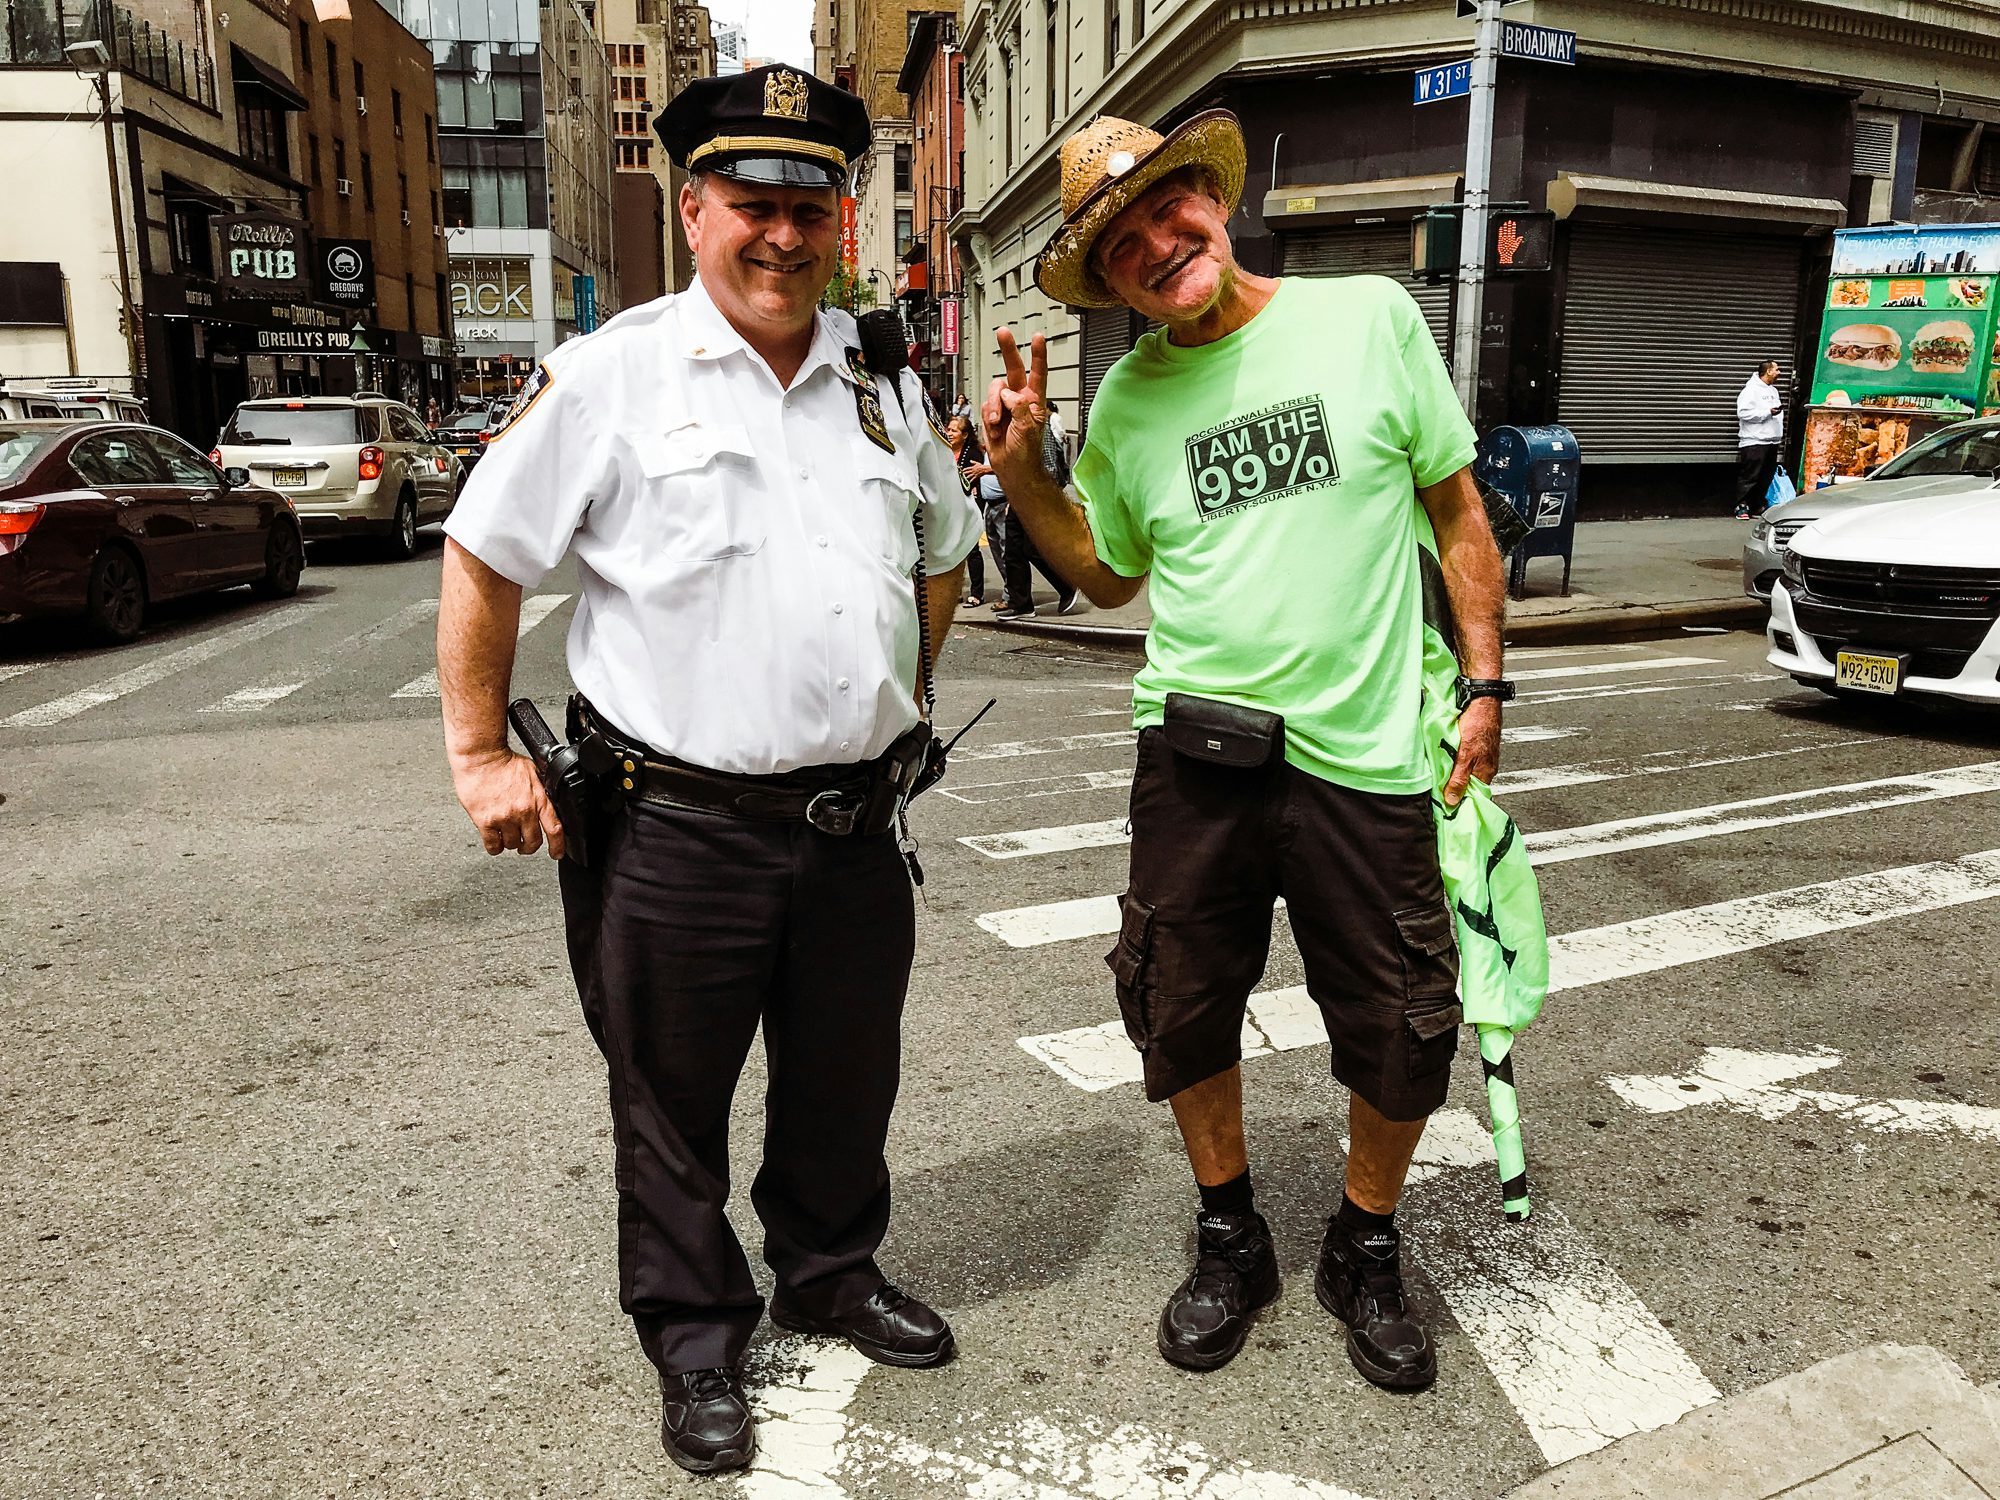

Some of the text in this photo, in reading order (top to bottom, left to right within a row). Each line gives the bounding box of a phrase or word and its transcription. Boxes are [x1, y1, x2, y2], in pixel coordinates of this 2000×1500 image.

[1506, 26, 1573, 60] BROADWAY
[1419, 65, 1467, 99] W 31 ST
[228, 224, 294, 247] O'Reilly's
[1869, 237, 1897, 250] YORK
[1897, 236, 1928, 250] BEST
[1928, 235, 1964, 249] HALAL
[229, 247, 297, 279] PUB
[330, 282, 364, 293] GREGORYS
[258, 331, 350, 348] O'REILLY'S PUB
[467, 324, 497, 339] rack
[944, 302, 955, 352] Costume Jewelry
[1185, 393, 1321, 445] #OCCUPYWALLSTREET
[1193, 407, 1322, 468] I AM THE
[1197, 434, 1330, 509] 99%
[1306, 479, 1341, 492] N.Y.C.
[1201, 1221, 1231, 1230] MONARCH
